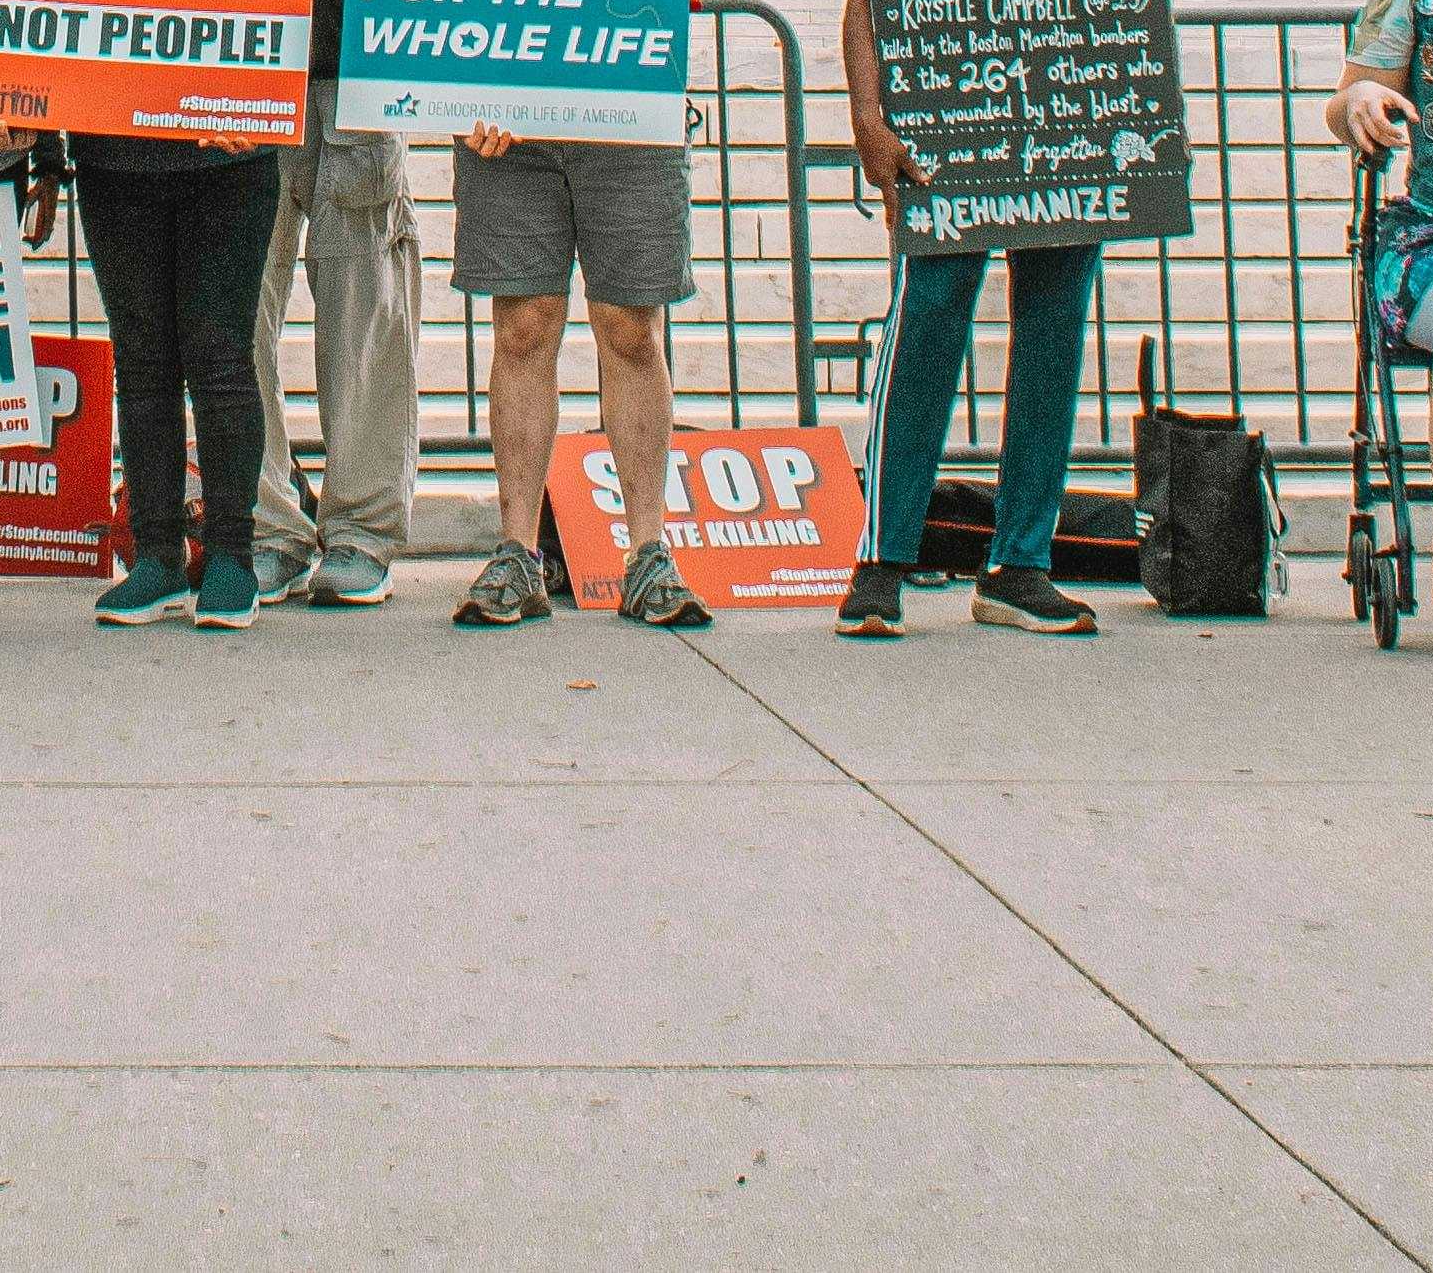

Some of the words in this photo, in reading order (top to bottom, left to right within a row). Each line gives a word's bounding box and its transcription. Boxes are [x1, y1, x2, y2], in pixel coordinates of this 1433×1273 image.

[98, 11, 284, 65] PEOPLE!
[363, 17, 551, 61] WHOLE
[563, 27, 673, 66] LIFE
[939, 32, 962, 54] the
[968, 30, 1014, 53] Boston
[890, 64, 910, 93] &
[916, 66, 951, 90] the
[960, 56, 1031, 93] 264
[1047, 55, 1118, 85] others
[1126, 49, 1164, 78] who
[428, 102, 501, 121] DEMOCRATS
[505, 105, 528, 121] FOR
[534, 106, 558, 121] LIFE
[563, 107, 578, 122] OF
[582, 108, 638, 124] AMERICA
[941, 94, 1012, 123] wounded
[1022, 93, 1044, 125] by
[1049, 93, 1081, 117] the
[1089, 86, 1142, 121] blast
[906, 185, 1130, 241] #REHUMANIZE
[706, 519, 821, 547] KILLING
